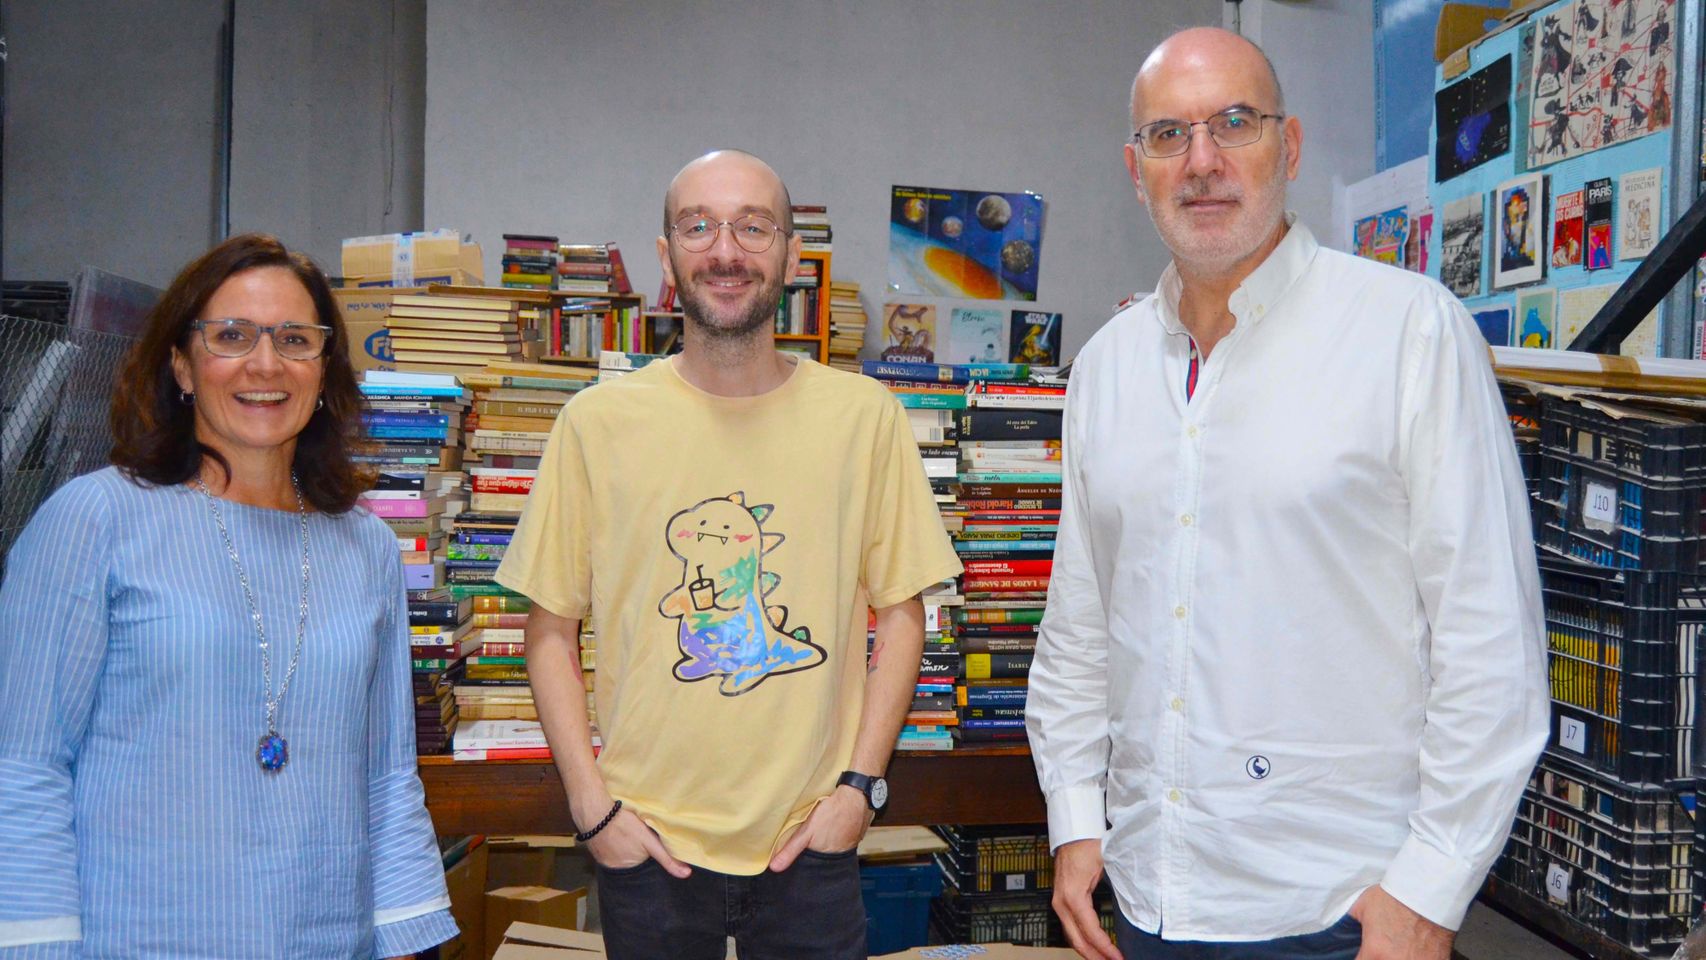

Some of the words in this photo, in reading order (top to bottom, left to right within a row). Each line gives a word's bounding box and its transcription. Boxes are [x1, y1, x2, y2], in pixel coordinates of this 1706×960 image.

[1589, 186, 1612, 199] PARIS
[886, 354, 927, 364] CONAN
[928, 448, 941, 456] lado
[986, 500, 1013, 510] Harold
[1593, 493, 1609, 511] J10
[1566, 723, 1578, 741] J7
[1551, 871, 1563, 890] J6
